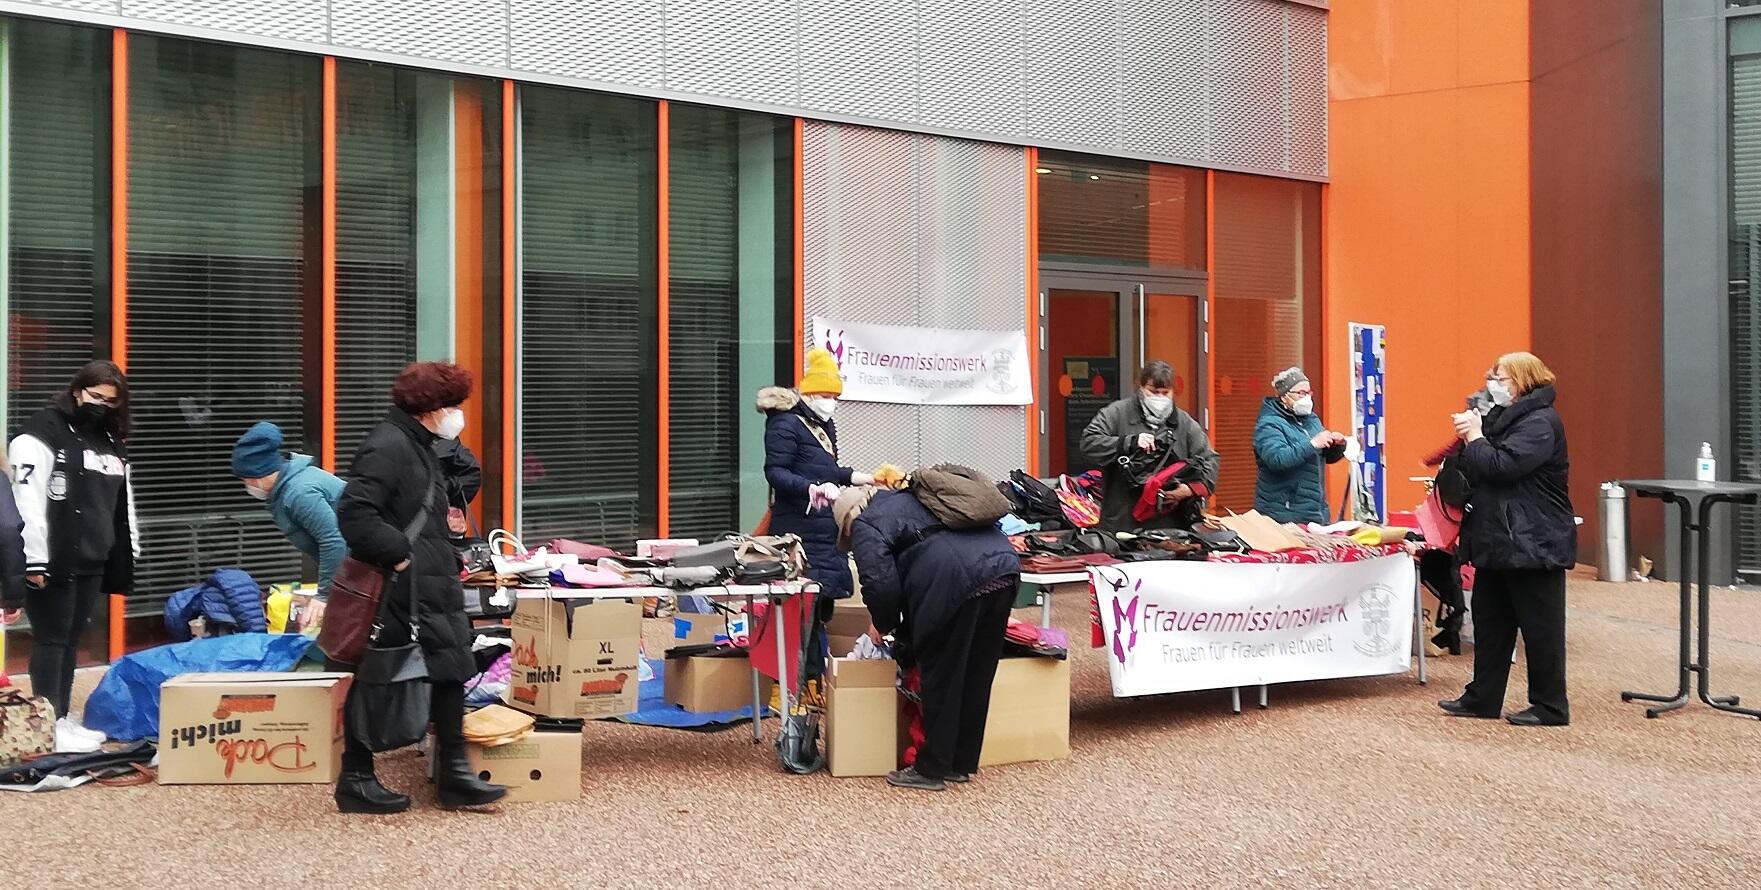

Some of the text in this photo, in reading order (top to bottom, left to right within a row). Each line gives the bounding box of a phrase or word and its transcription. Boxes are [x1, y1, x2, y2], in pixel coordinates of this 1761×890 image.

[848, 346, 987, 372] Frauenmissionswerk
[859, 371, 889, 386] Frauen
[892, 373, 908, 387] für
[909, 375, 941, 389] Frauen
[1143, 597, 1349, 633] Frauenmissionswerk
[598, 641, 614, 654] XL
[1162, 643, 1206, 664] Frauen
[1209, 640, 1228, 661] für
[1231, 641, 1276, 660] Frauen
[1278, 634, 1334, 657] weltweit
[526, 664, 562, 684] mich!
[171, 719, 241, 749] mich!
[215, 735, 317, 780] Pack
